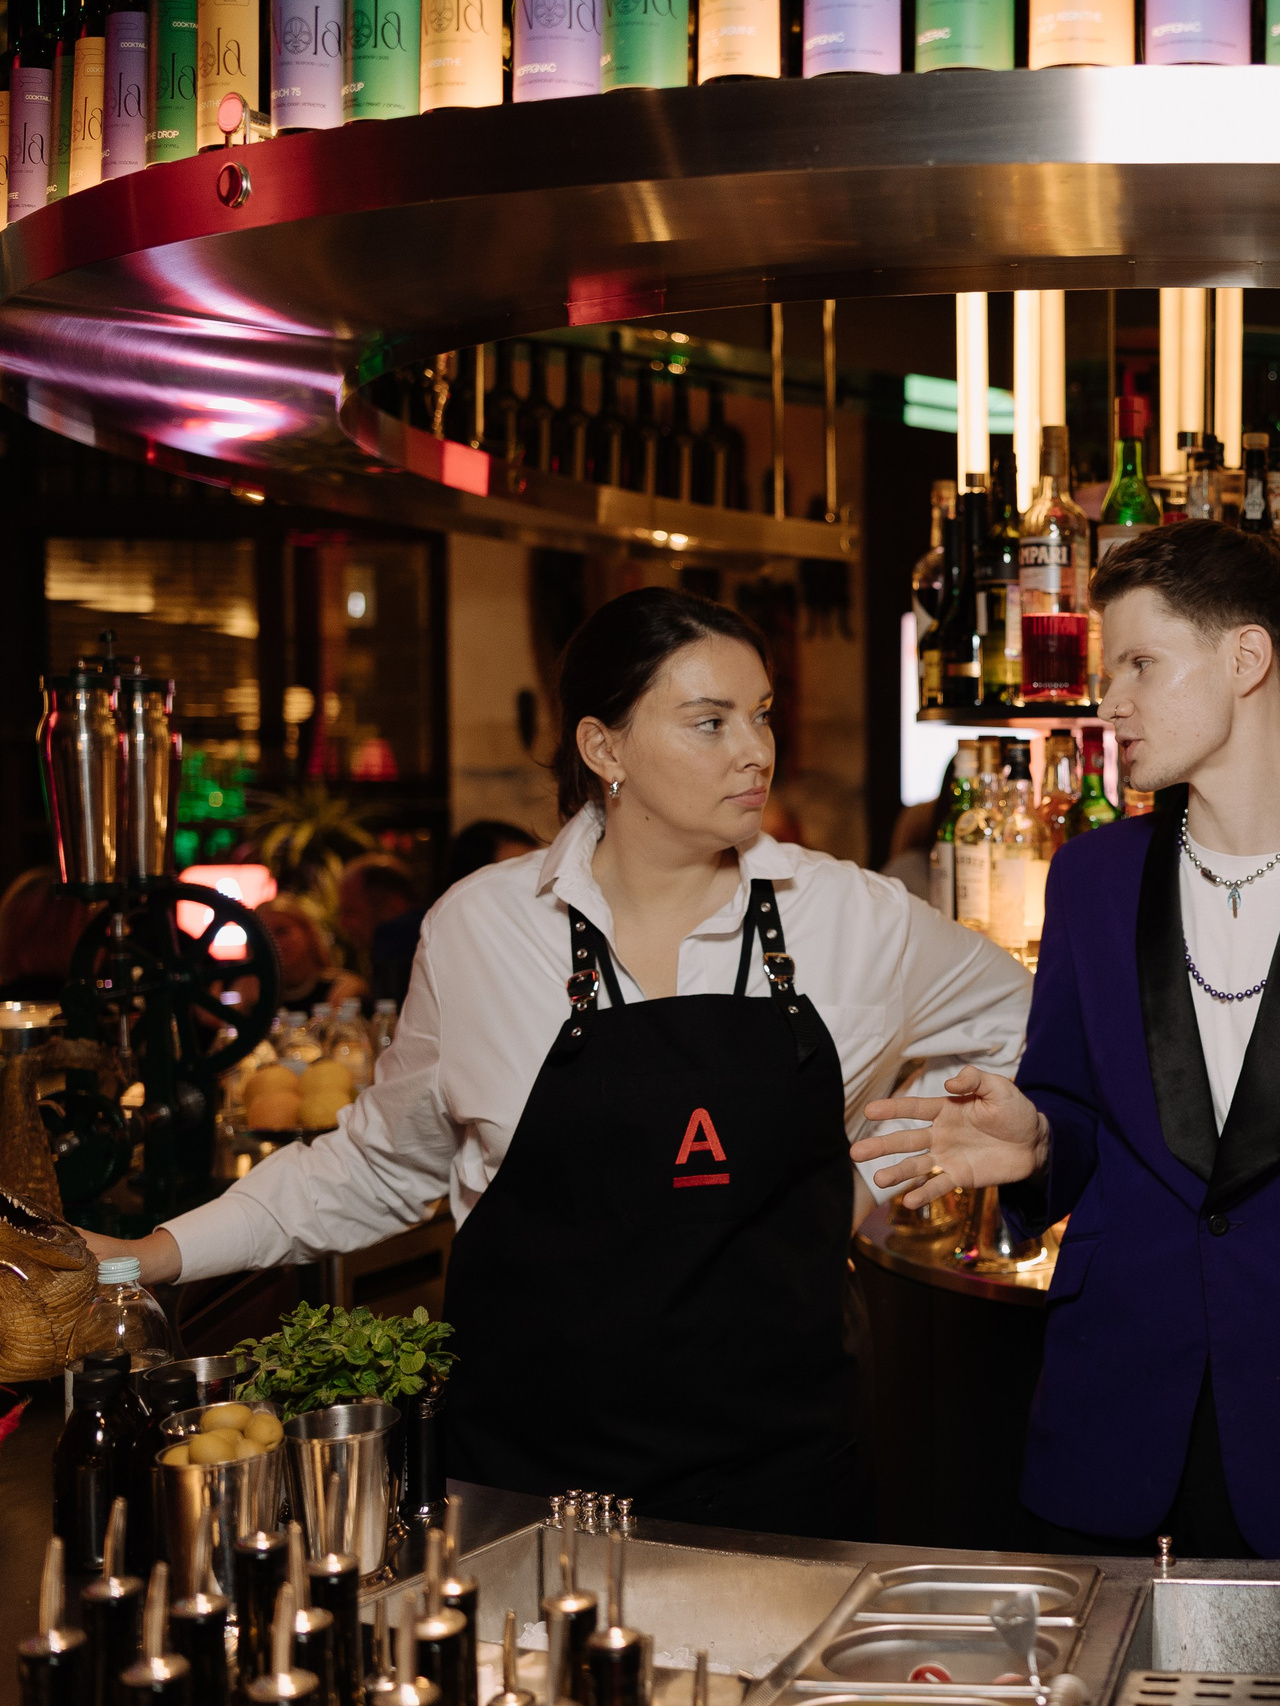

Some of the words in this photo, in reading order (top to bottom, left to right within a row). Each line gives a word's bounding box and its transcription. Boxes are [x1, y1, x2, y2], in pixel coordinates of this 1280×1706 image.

[291, 87, 302, 97] 75
[157, 130, 180, 140] DROP
[1020, 545, 1069, 566] MPARI
[675, 1107, 727, 1165] A
